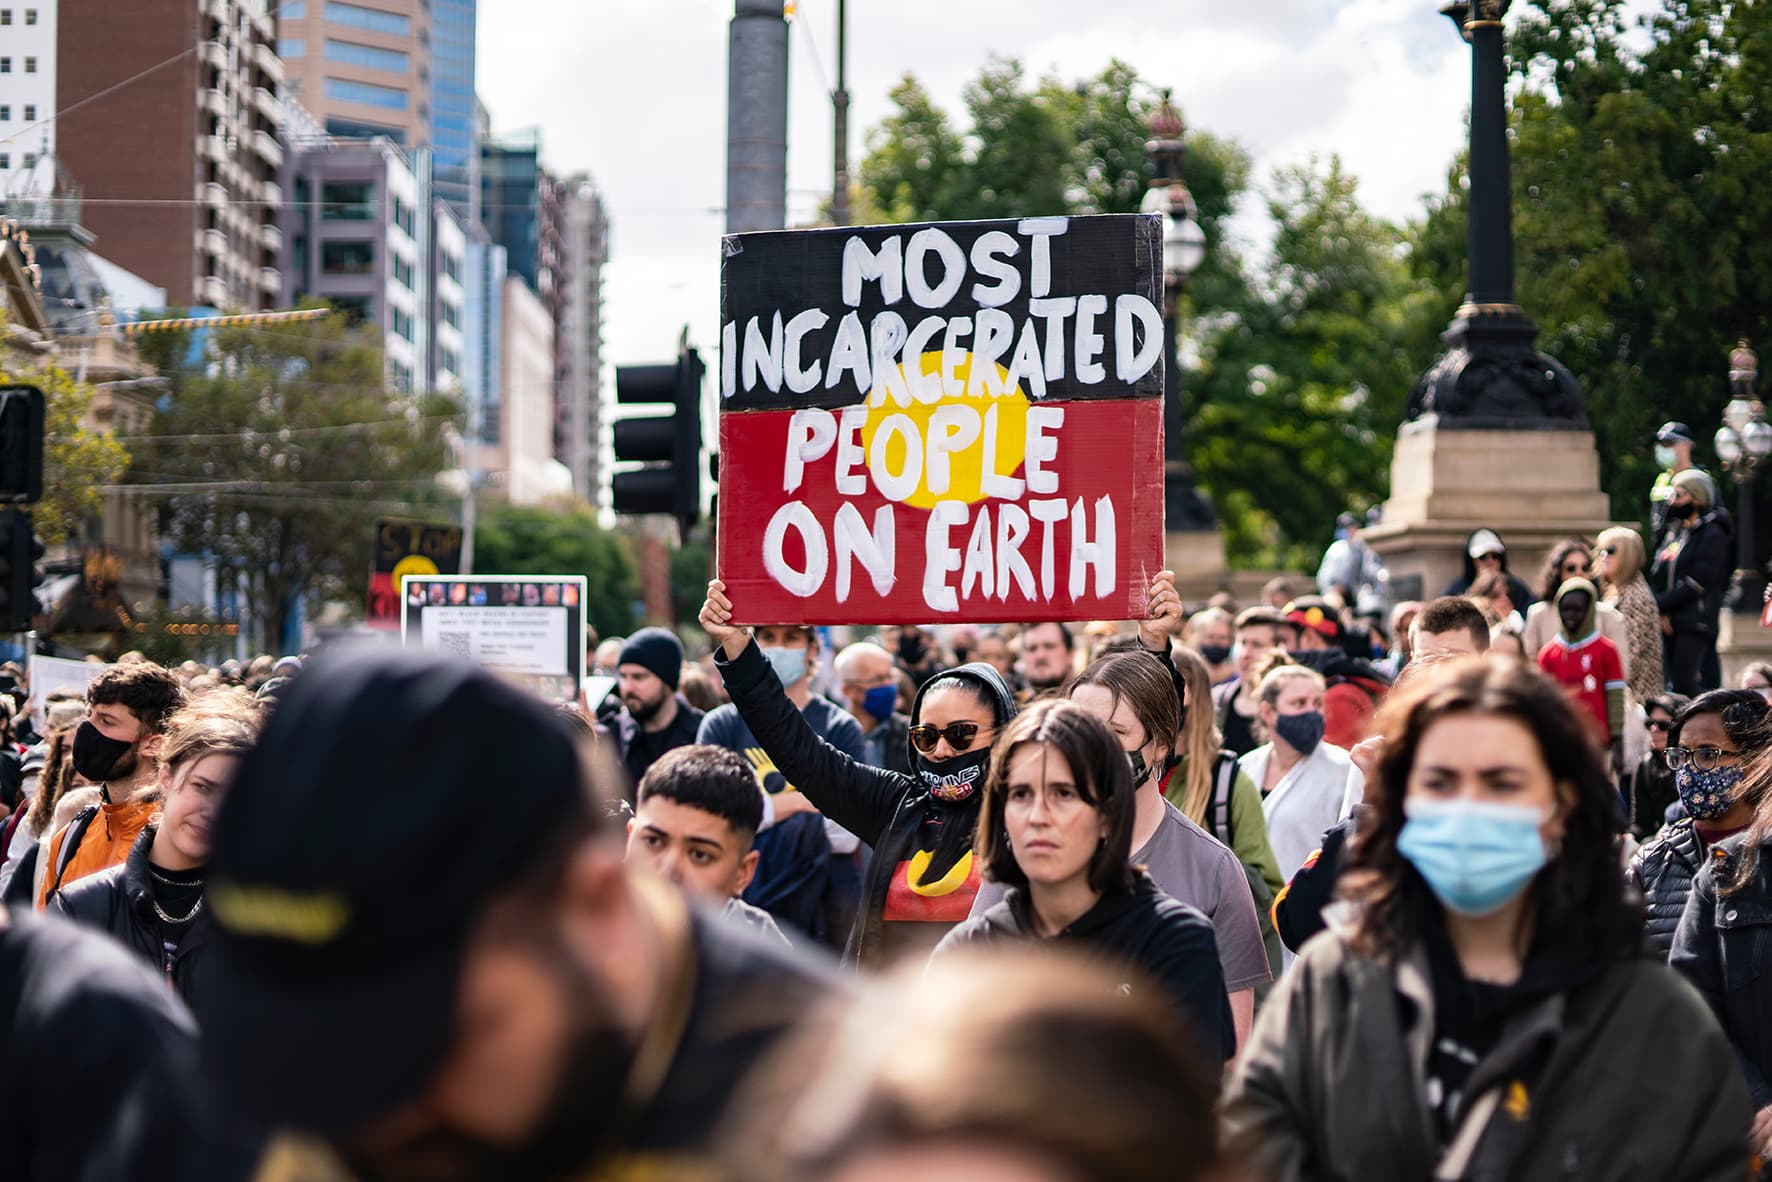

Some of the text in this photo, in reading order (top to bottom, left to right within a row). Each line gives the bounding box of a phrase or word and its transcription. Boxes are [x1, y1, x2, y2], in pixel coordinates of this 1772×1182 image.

[842, 217, 1069, 308] MOST
[722, 294, 1164, 409] INCARCERATED
[783, 403, 1065, 502] PEOPLE
[381, 524, 461, 556] STOP
[763, 493, 1117, 612] ON EARTH
